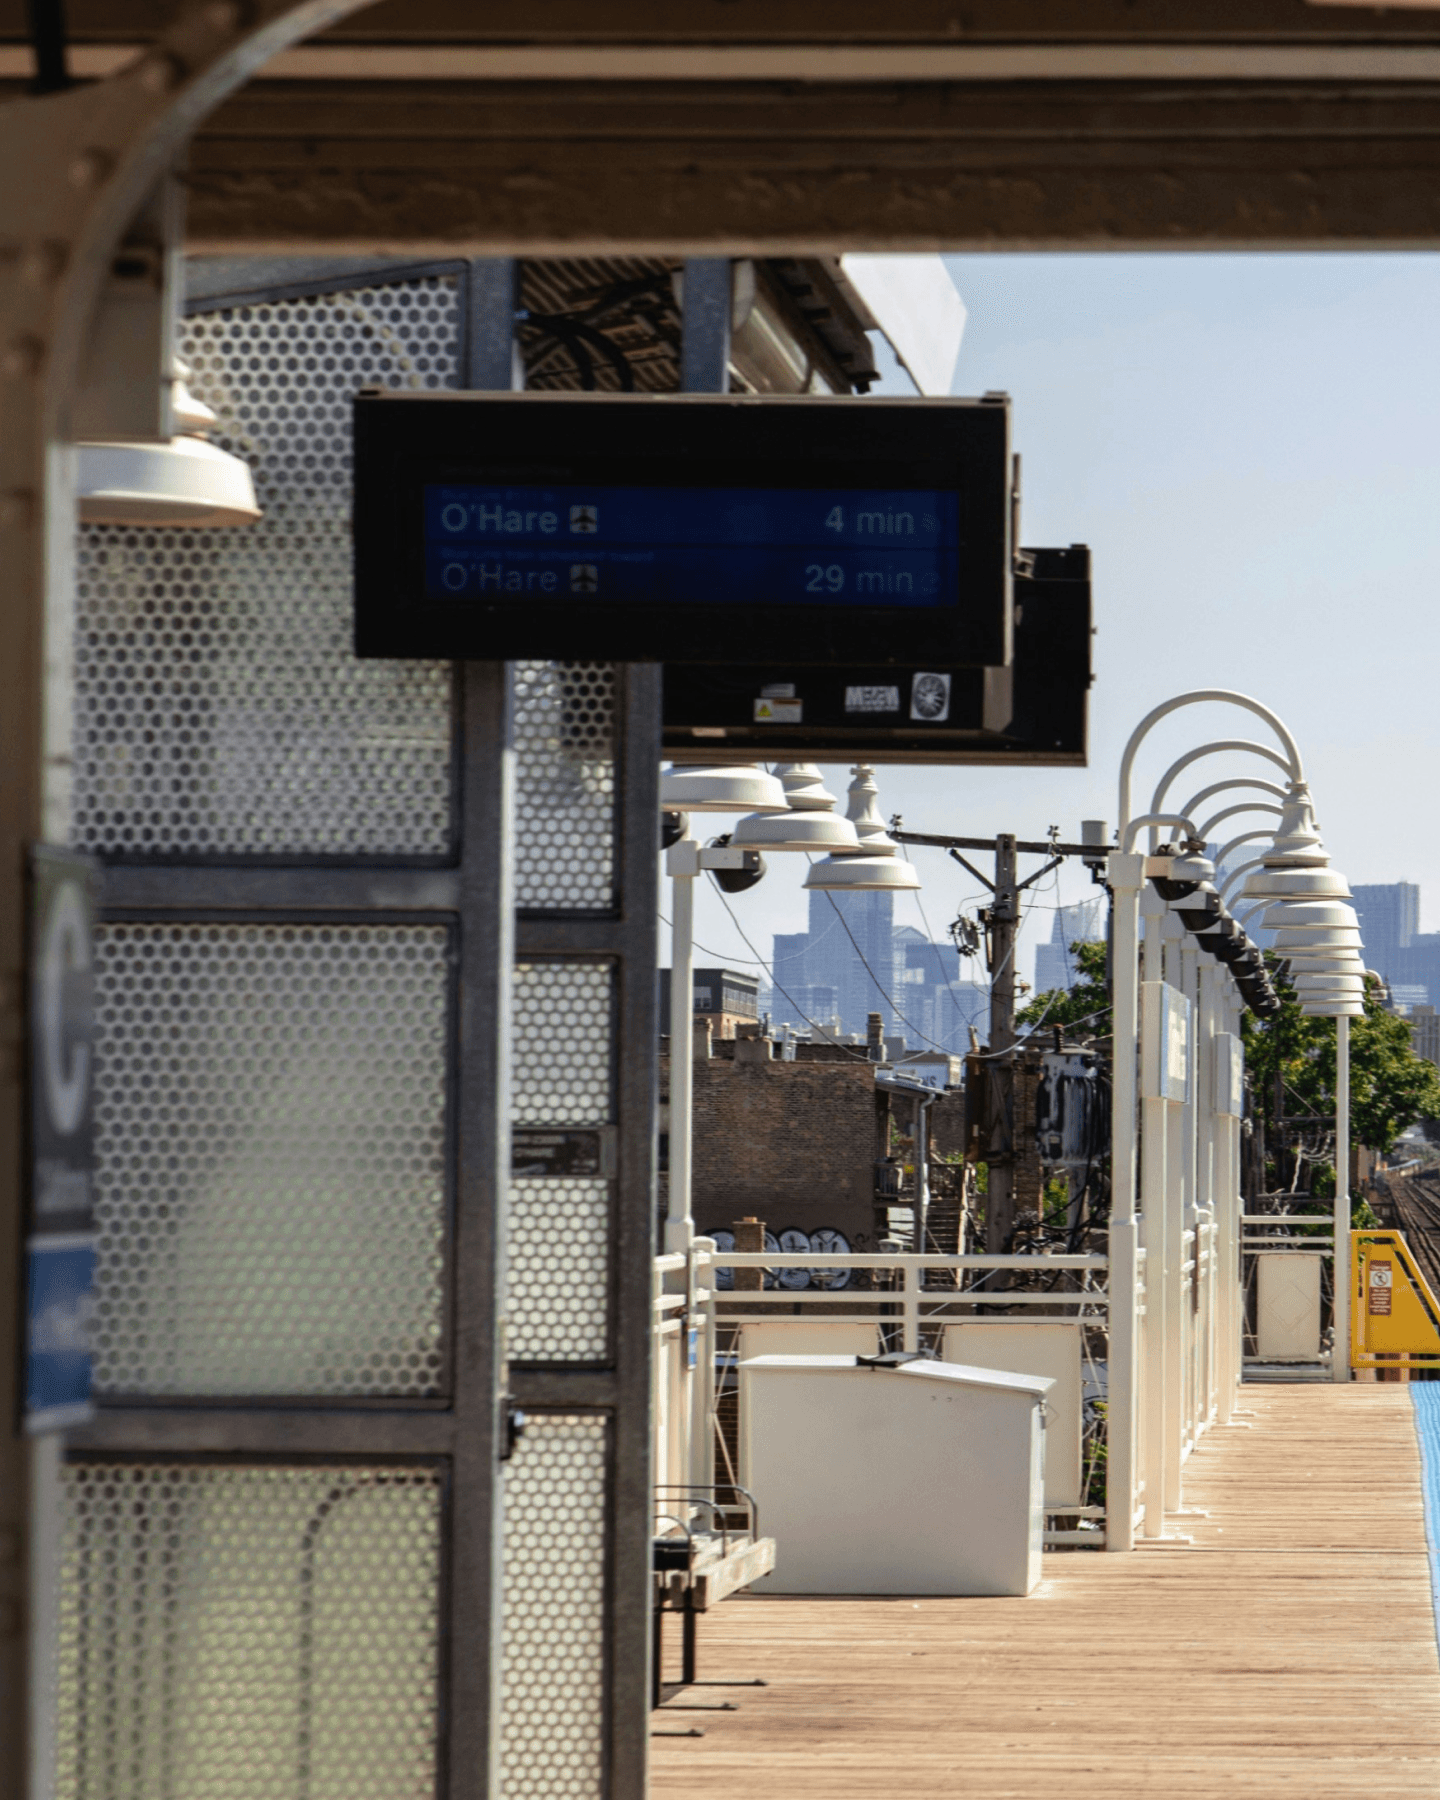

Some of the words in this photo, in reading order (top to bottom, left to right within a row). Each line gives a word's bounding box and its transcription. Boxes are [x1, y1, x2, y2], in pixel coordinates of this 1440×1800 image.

[441, 503, 559, 533] O'Hare
[825, 505, 844, 533] 4
[856, 506, 915, 534] min
[441, 562, 559, 592] O'Hare
[805, 564, 845, 593] 29
[856, 565, 914, 593] min
